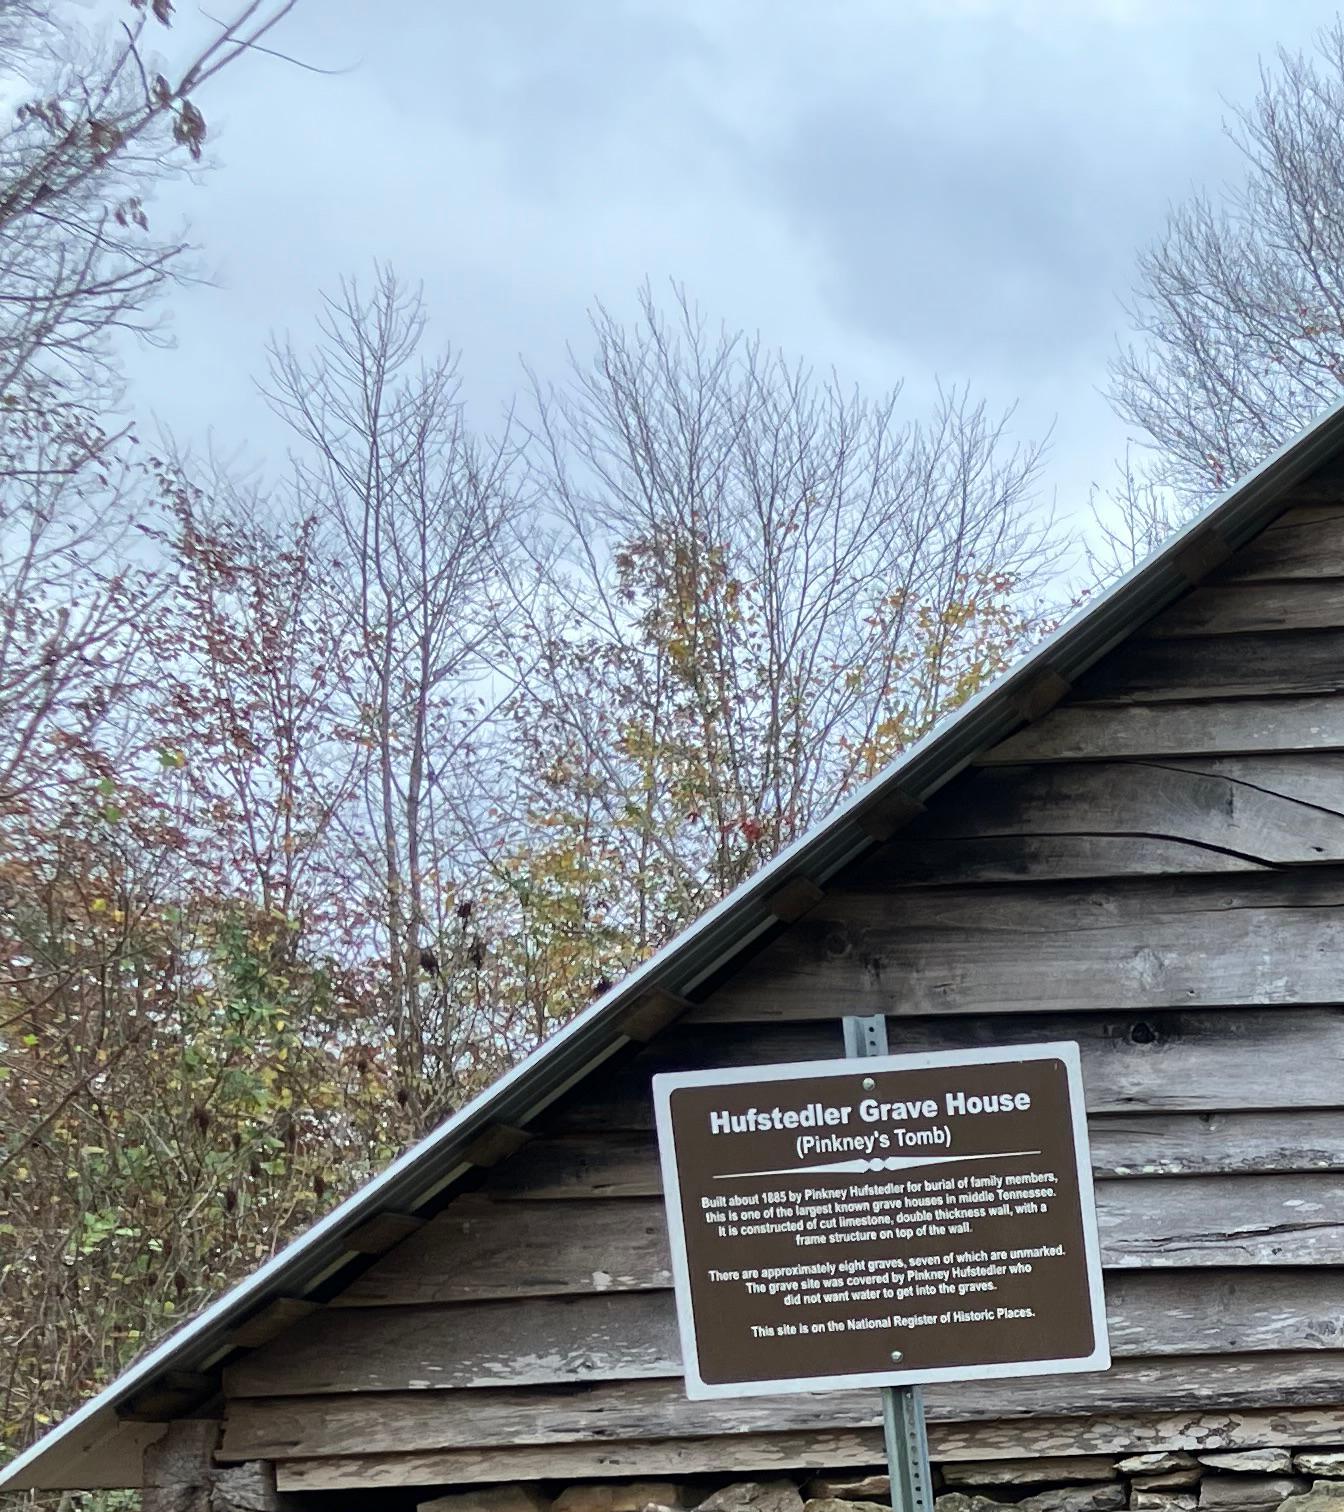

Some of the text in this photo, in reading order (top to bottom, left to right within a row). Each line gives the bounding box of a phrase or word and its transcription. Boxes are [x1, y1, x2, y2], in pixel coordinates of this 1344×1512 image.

[710, 1092, 1031, 1134] Hufstedler Grave House
[797, 1125, 951, 1159] (Pinkney's Tomb)
[701, 1196, 728, 1209] Built
[729, 1194, 760, 1207] about
[789, 1191, 802, 1204] by
[804, 1188, 848, 1201] Pinkney
[849, 1183, 905, 1197] Hufstedler
[907, 1181, 922, 1193] for
[924, 1178, 956, 1192] burial
[957, 1177, 969, 1189] of
[970, 1175, 1003, 1189] family
[706, 1188, 1057, 1223] this is one of the largest known grave houses in middle Tennessee.
[728, 1225, 739, 1236] is
[741, 1220, 804, 1236] constructed
[806, 1218, 818, 1230] of
[820, 1218, 837, 1229] cut
[896, 1210, 933, 1223] double
[935, 1208, 987, 1221] thickness
[1015, 1202, 1038, 1214] with
[1041, 1203, 1048, 1213] a
[796, 1222, 972, 1246] frame structure on top of the wall.
[708, 1270, 740, 1282] There
[742, 1270, 759, 1280] are
[761, 1262, 836, 1280] approximately
[839, 1260, 866, 1274] eight
[909, 1256, 941, 1267] seven
[943, 1252, 954, 1265] of
[956, 1250, 989, 1263] which
[991, 1251, 1008, 1261] are
[1010, 1244, 1066, 1260] unmarked.
[745, 1262, 1032, 1295] The grave site was covered by Pinkney Hufstedler who
[784, 1281, 997, 1306] did not want water to get into the graves.
[751, 1308, 1036, 1338] This site is on the National Register of Historic Places.
